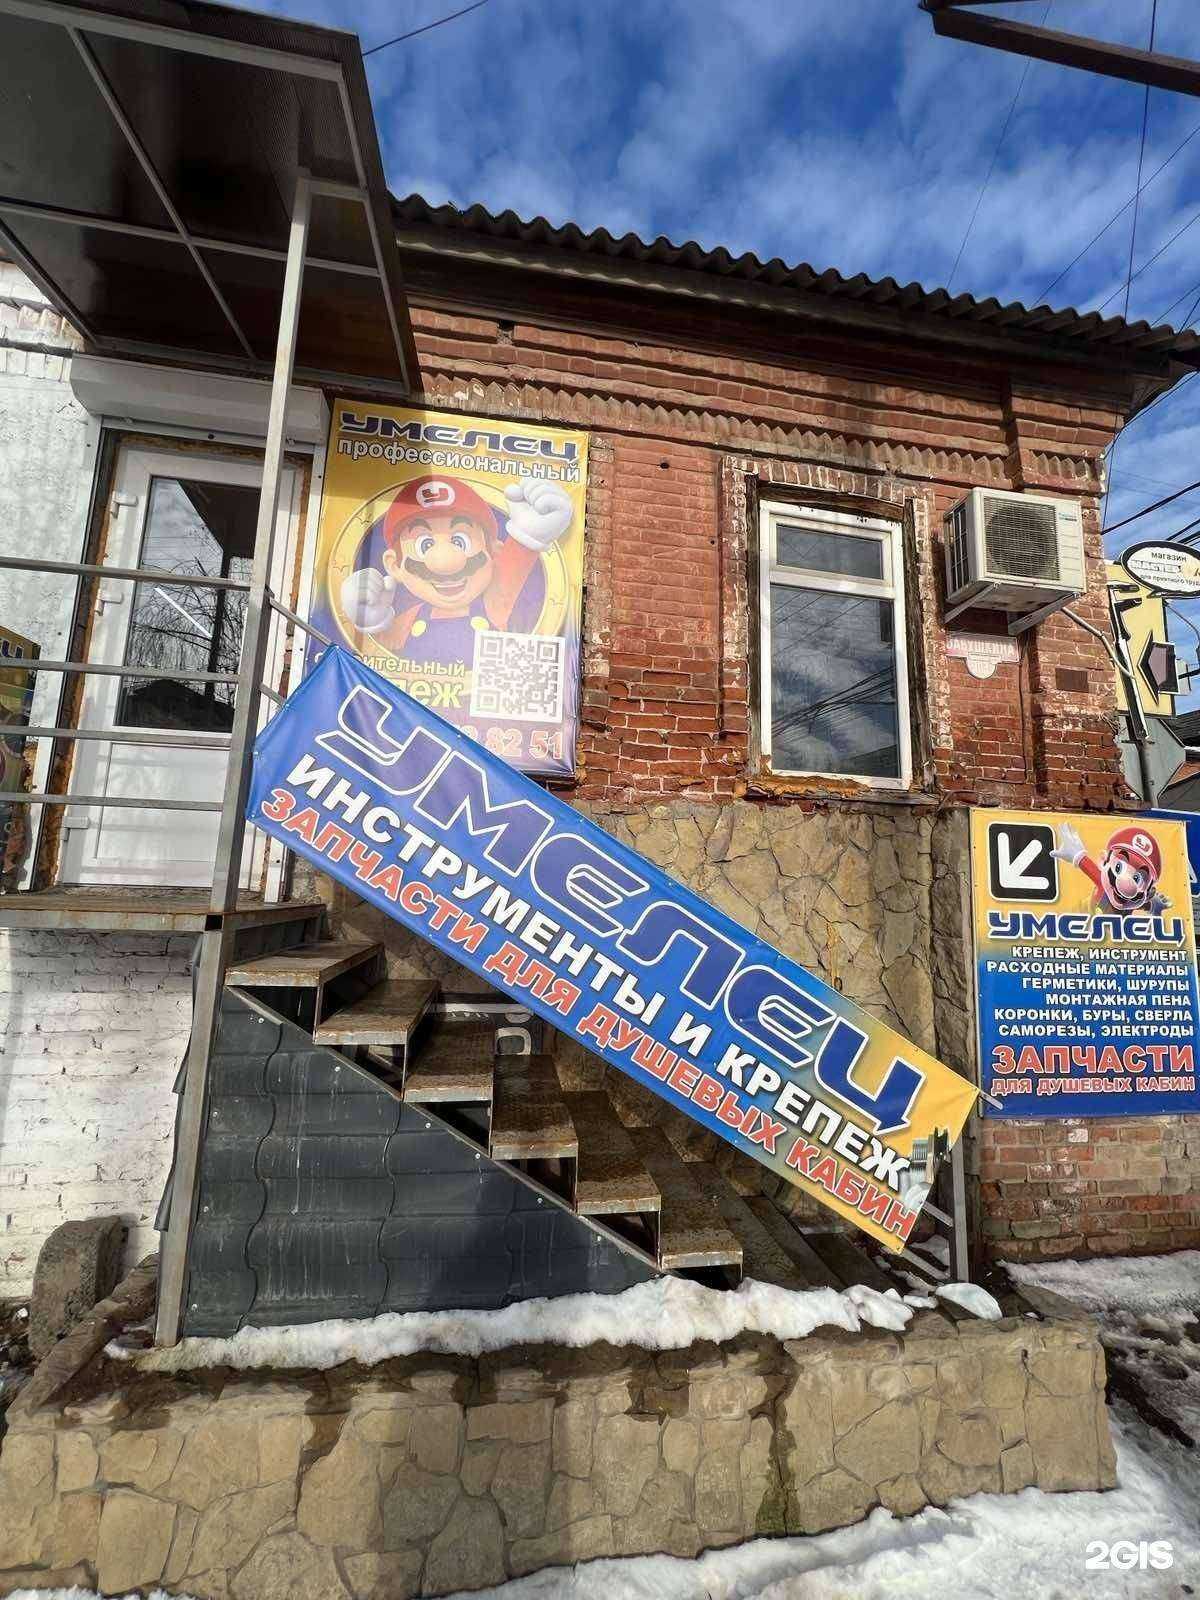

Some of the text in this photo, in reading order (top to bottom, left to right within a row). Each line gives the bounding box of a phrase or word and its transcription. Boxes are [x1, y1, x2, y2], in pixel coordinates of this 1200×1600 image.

[340, 412, 579, 463] УМЕЛЕЦ
[337, 438, 580, 482] профессиональный
[1151, 552, 1186, 561] магазин
[529, 730, 562, 760] 51
[315, 684, 926, 1135] УМЕЛЕЦ
[987, 912, 1186, 947] УМЕЛЕЦ
[1012, 946, 1187, 962] КРЕПЕЖ, ИНСТРУМЕНТ
[286, 754, 912, 1191] ИНСТРУМЕНТЫ И КРЕПЕЖ
[987, 961, 1188, 976] РАСХОДНЫЕ МАТЕРИАЛЫ
[1022, 977, 1189, 993] ГЕРМЕТИКИ, ШУРУПЫ
[1046, 993, 1191, 1006] МОНТАЖНАЯ ПЕНА
[261, 788, 489, 953] ЗАПЧАСТИ
[484, 941, 581, 1016] ДЛЯ
[579, 1002, 787, 1154] ДУШЕВЫХ
[784, 1136, 918, 1240] КАБИН
[994, 1008, 1193, 1023] КОРОНКИ, БУРЫ, СВЕРЛА
[999, 1024, 1194, 1039] САМОРЕЗЫ, ЭЛЕКТРОДЫ
[992, 1044, 1195, 1075] ЗАПЧАСТИ
[991, 1076, 1196, 1096] ДЛЯ ДУШЕВЫХ КАБИН
